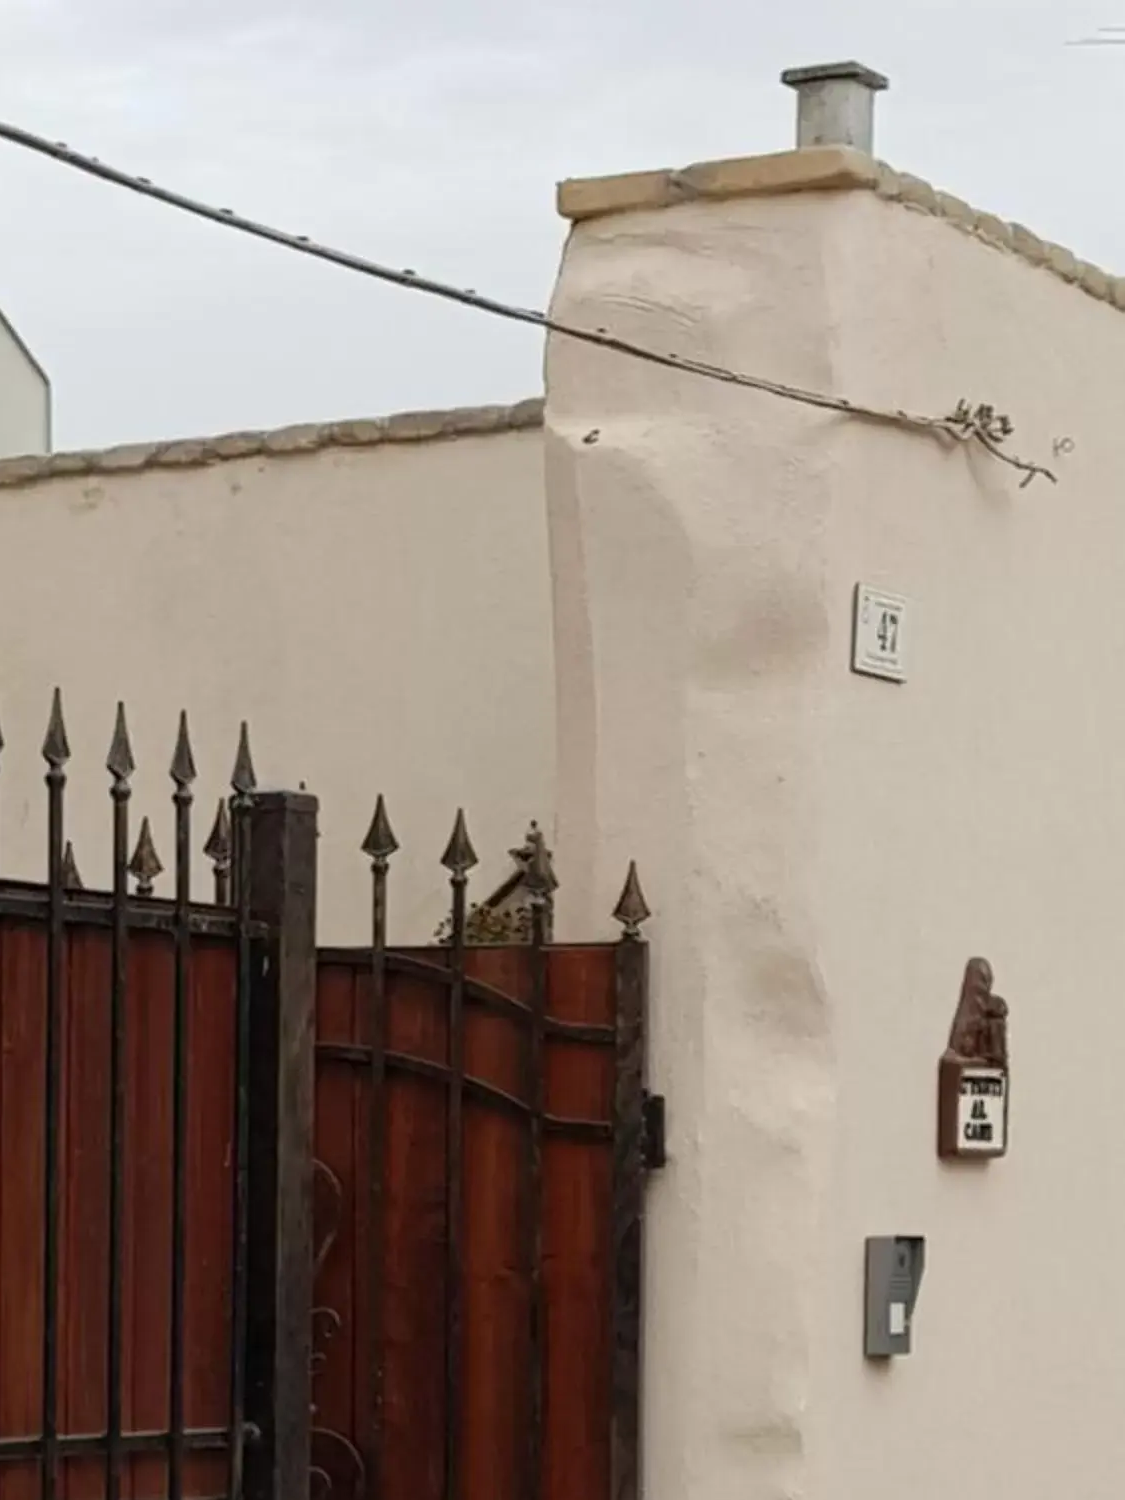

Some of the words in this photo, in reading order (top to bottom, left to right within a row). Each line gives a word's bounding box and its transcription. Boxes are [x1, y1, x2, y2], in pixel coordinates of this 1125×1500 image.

[877, 610, 899, 653] 47
[970, 1099, 988, 1120] AL
[963, 1123, 993, 1141] CANE
